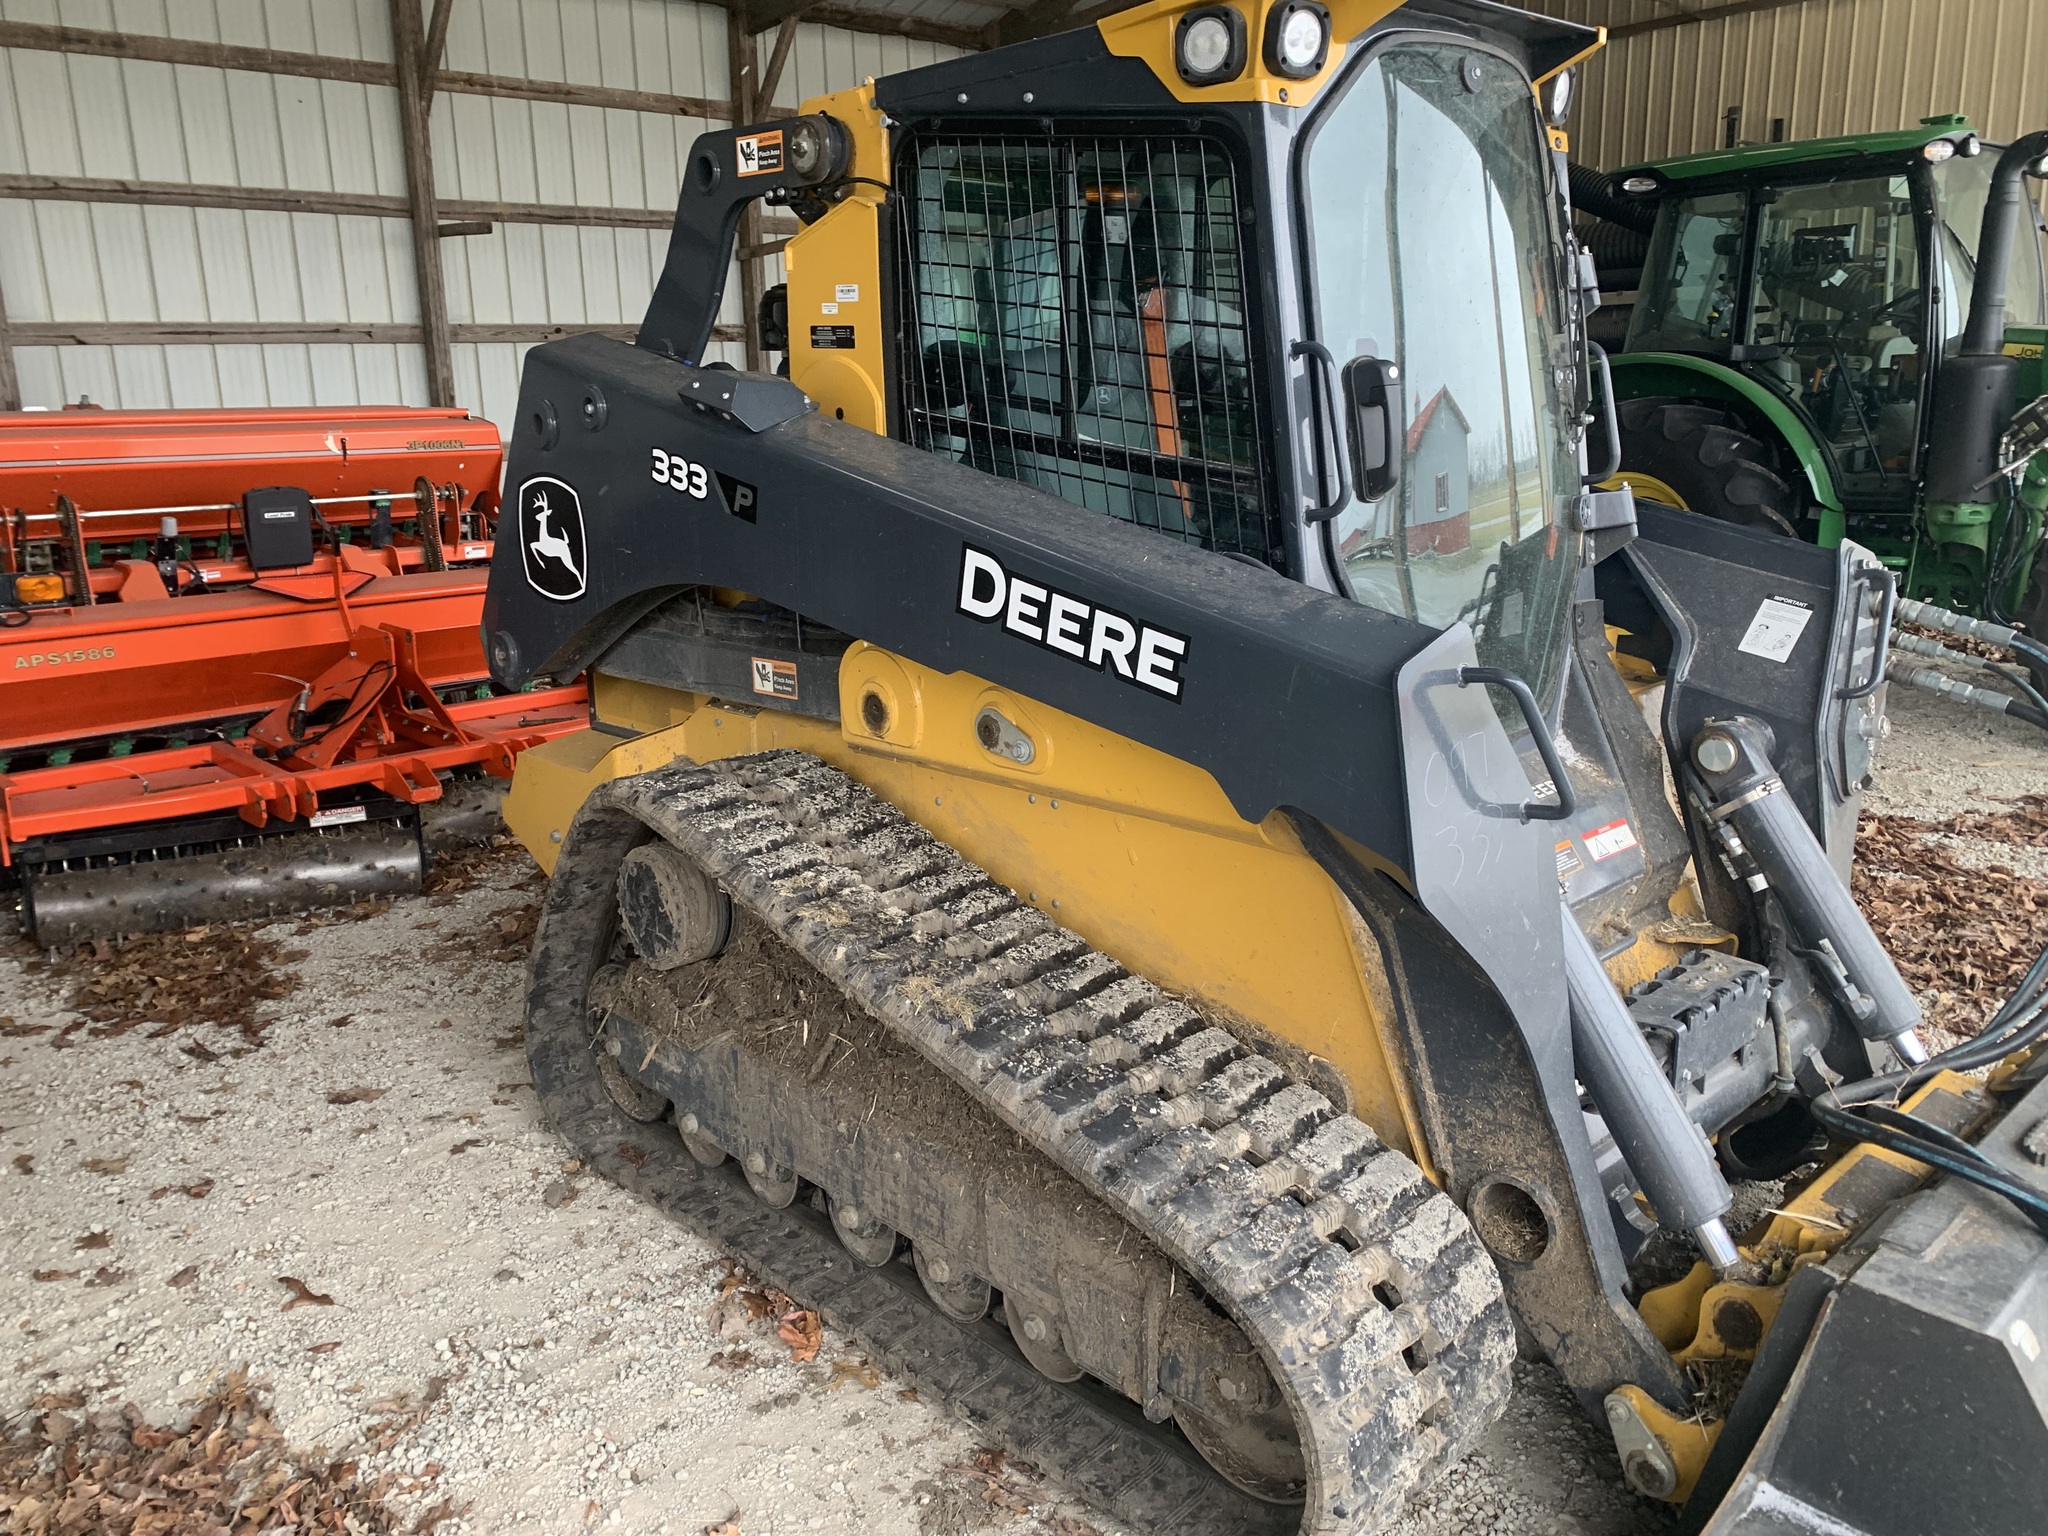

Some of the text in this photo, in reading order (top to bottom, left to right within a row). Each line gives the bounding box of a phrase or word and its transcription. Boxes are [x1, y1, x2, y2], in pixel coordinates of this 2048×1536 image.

[651, 448, 754, 513] 333 P
[960, 547, 1186, 697] DEERE
[1773, 595, 1808, 608] IMPORTANT
[14, 646, 116, 670] APS1586
[1424, 731, 1488, 808] 097
[331, 806, 363, 815] DANGER
